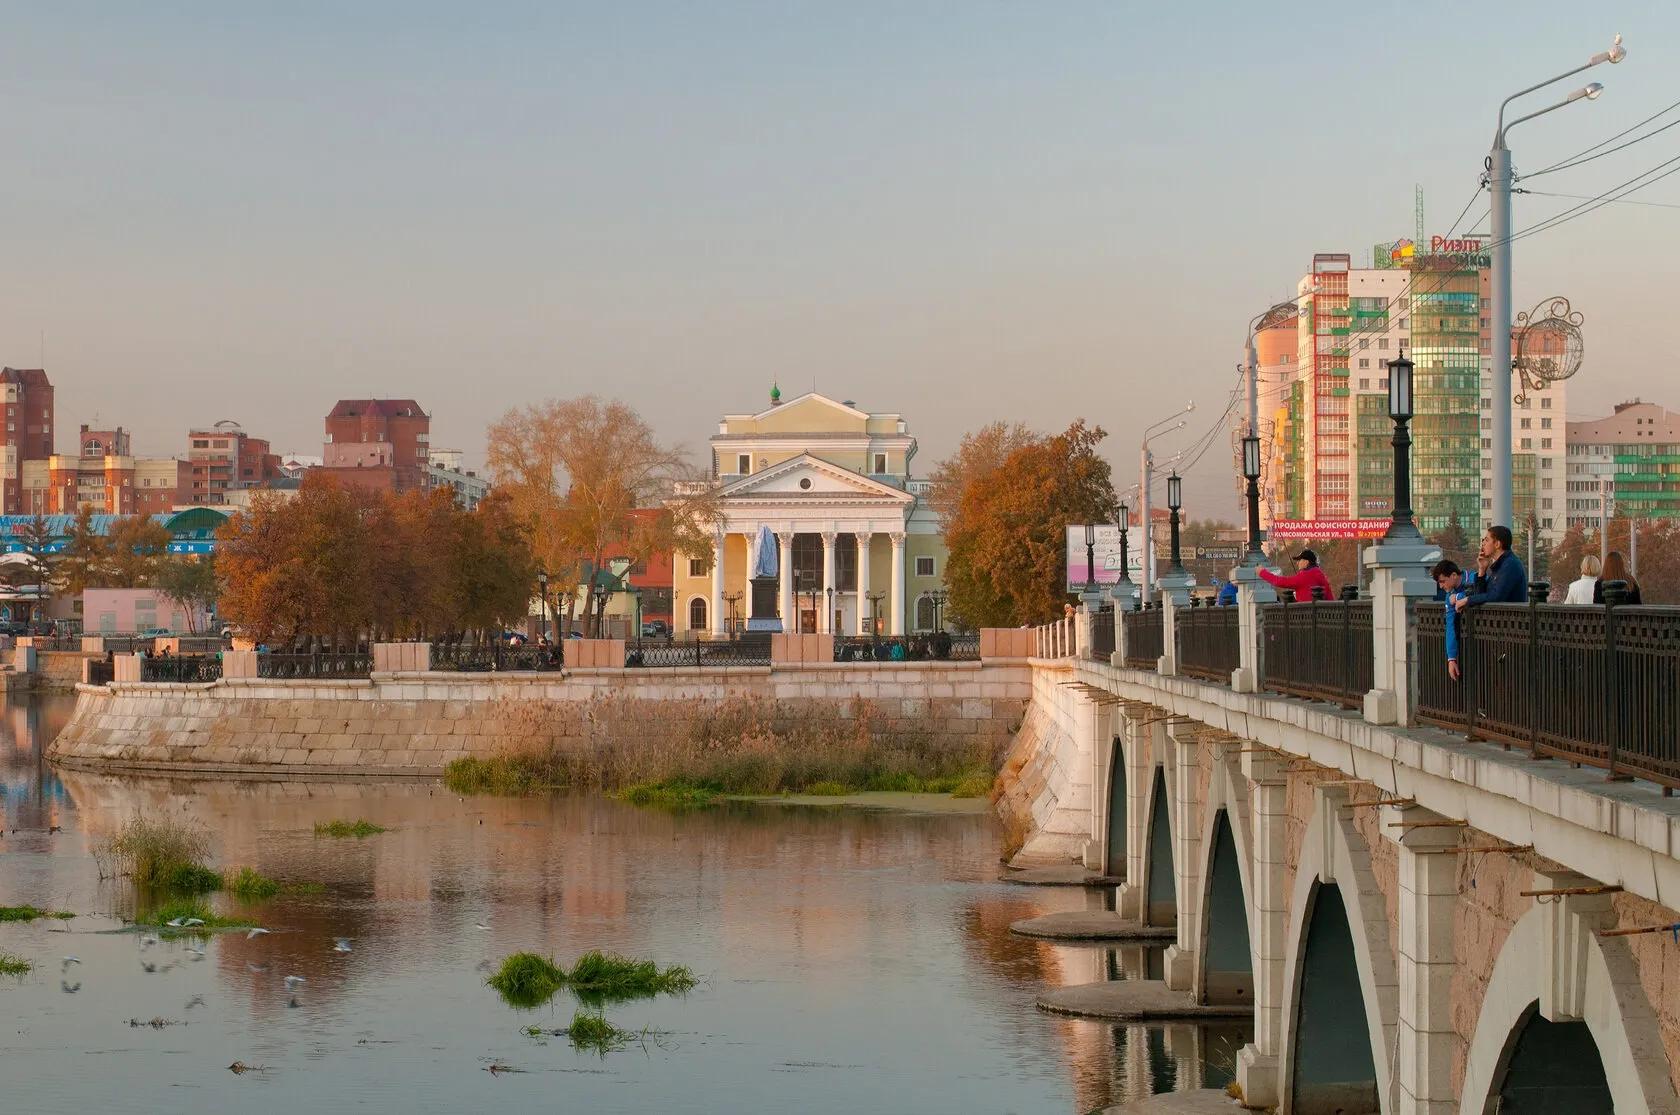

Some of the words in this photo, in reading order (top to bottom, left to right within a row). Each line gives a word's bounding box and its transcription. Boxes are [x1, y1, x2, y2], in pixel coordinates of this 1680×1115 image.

[1432, 235, 1480, 254] Риэлт
[1274, 522, 1313, 530] ПРОДАЖА
[1358, 521, 1390, 530] ЗДАНИЯ
